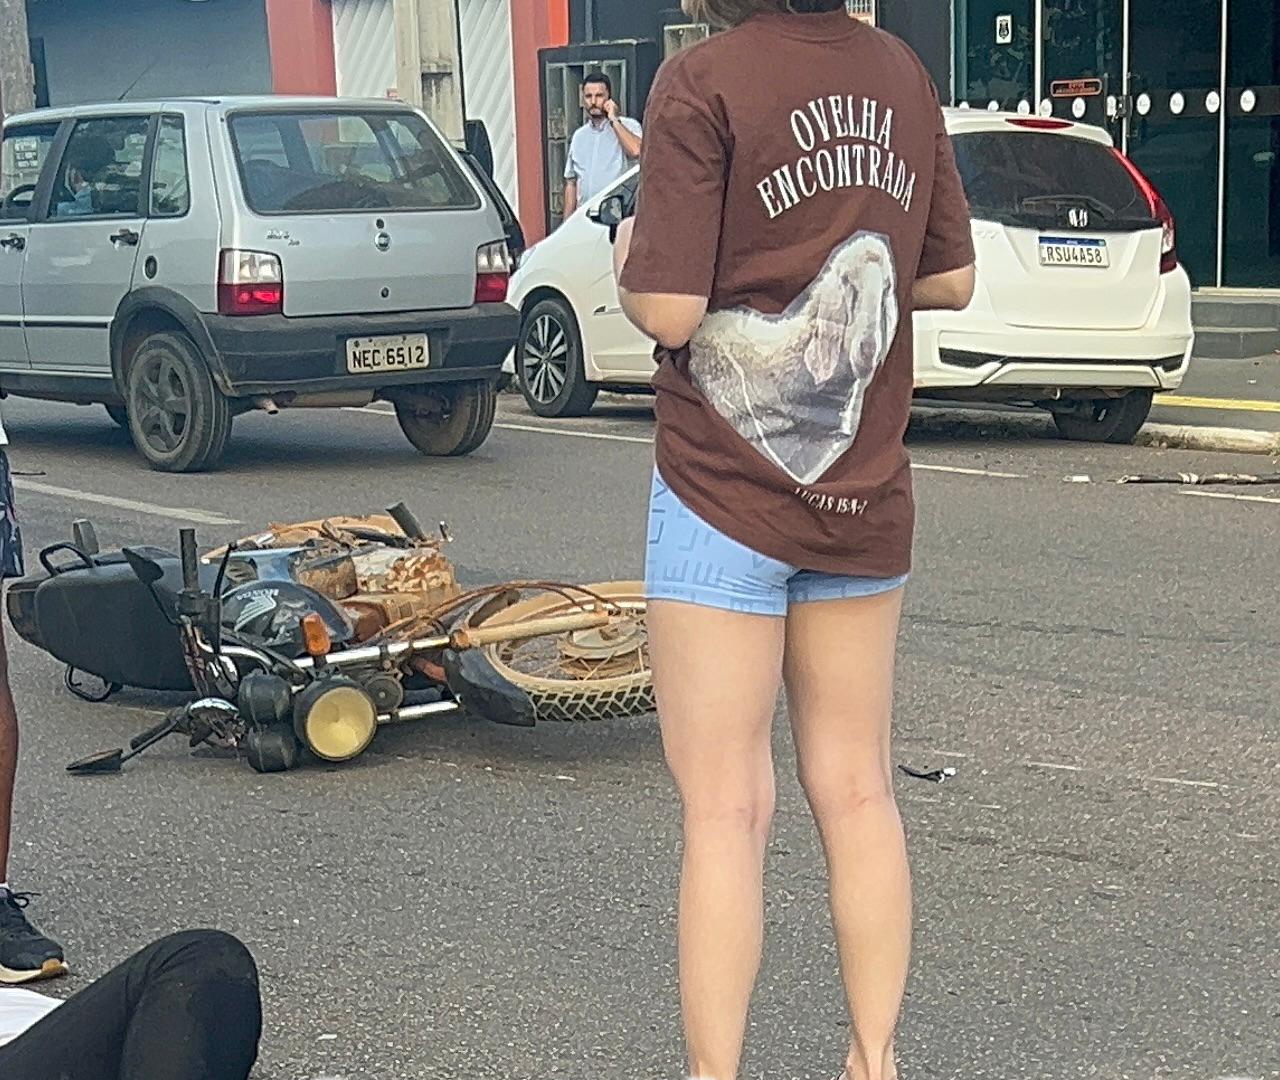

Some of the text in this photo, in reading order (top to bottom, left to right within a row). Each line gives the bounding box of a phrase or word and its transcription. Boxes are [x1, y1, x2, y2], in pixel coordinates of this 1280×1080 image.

[790, 94, 893, 151] OVELHA
[756, 144, 916, 219] ENCONTRADA
[1046, 246, 1102, 263] RSU4A58
